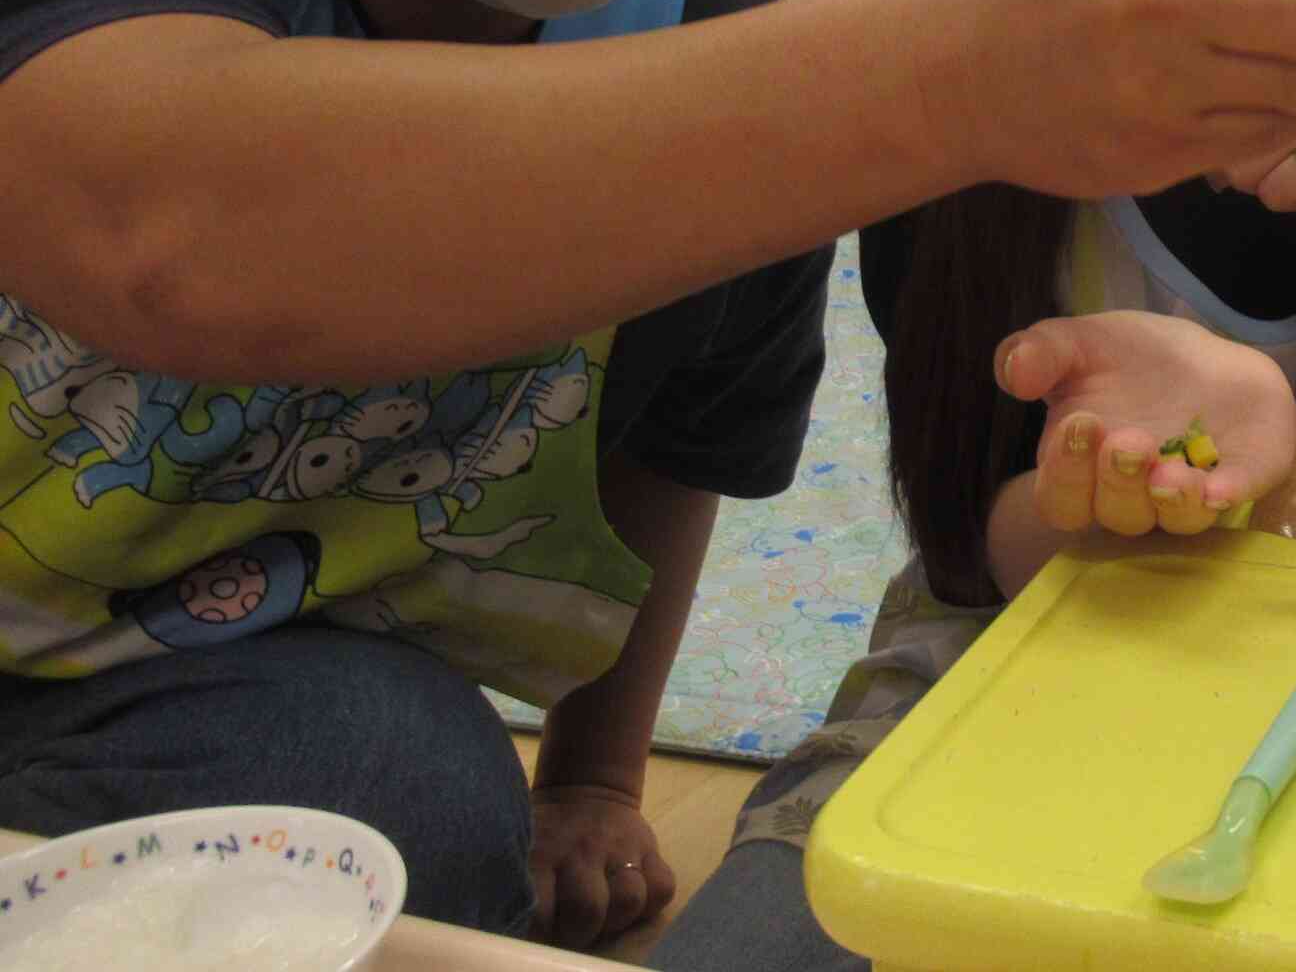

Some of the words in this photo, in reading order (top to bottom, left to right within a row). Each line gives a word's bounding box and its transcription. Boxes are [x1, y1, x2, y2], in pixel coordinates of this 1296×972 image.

[24, 873, 46, 899] K
[81, 846, 95, 868] L
[138, 833, 160, 858] M
[215, 833, 239, 860] N
[268, 829, 286, 852] O
[303, 848, 315, 868] P
[339, 848, 353, 874] Q
